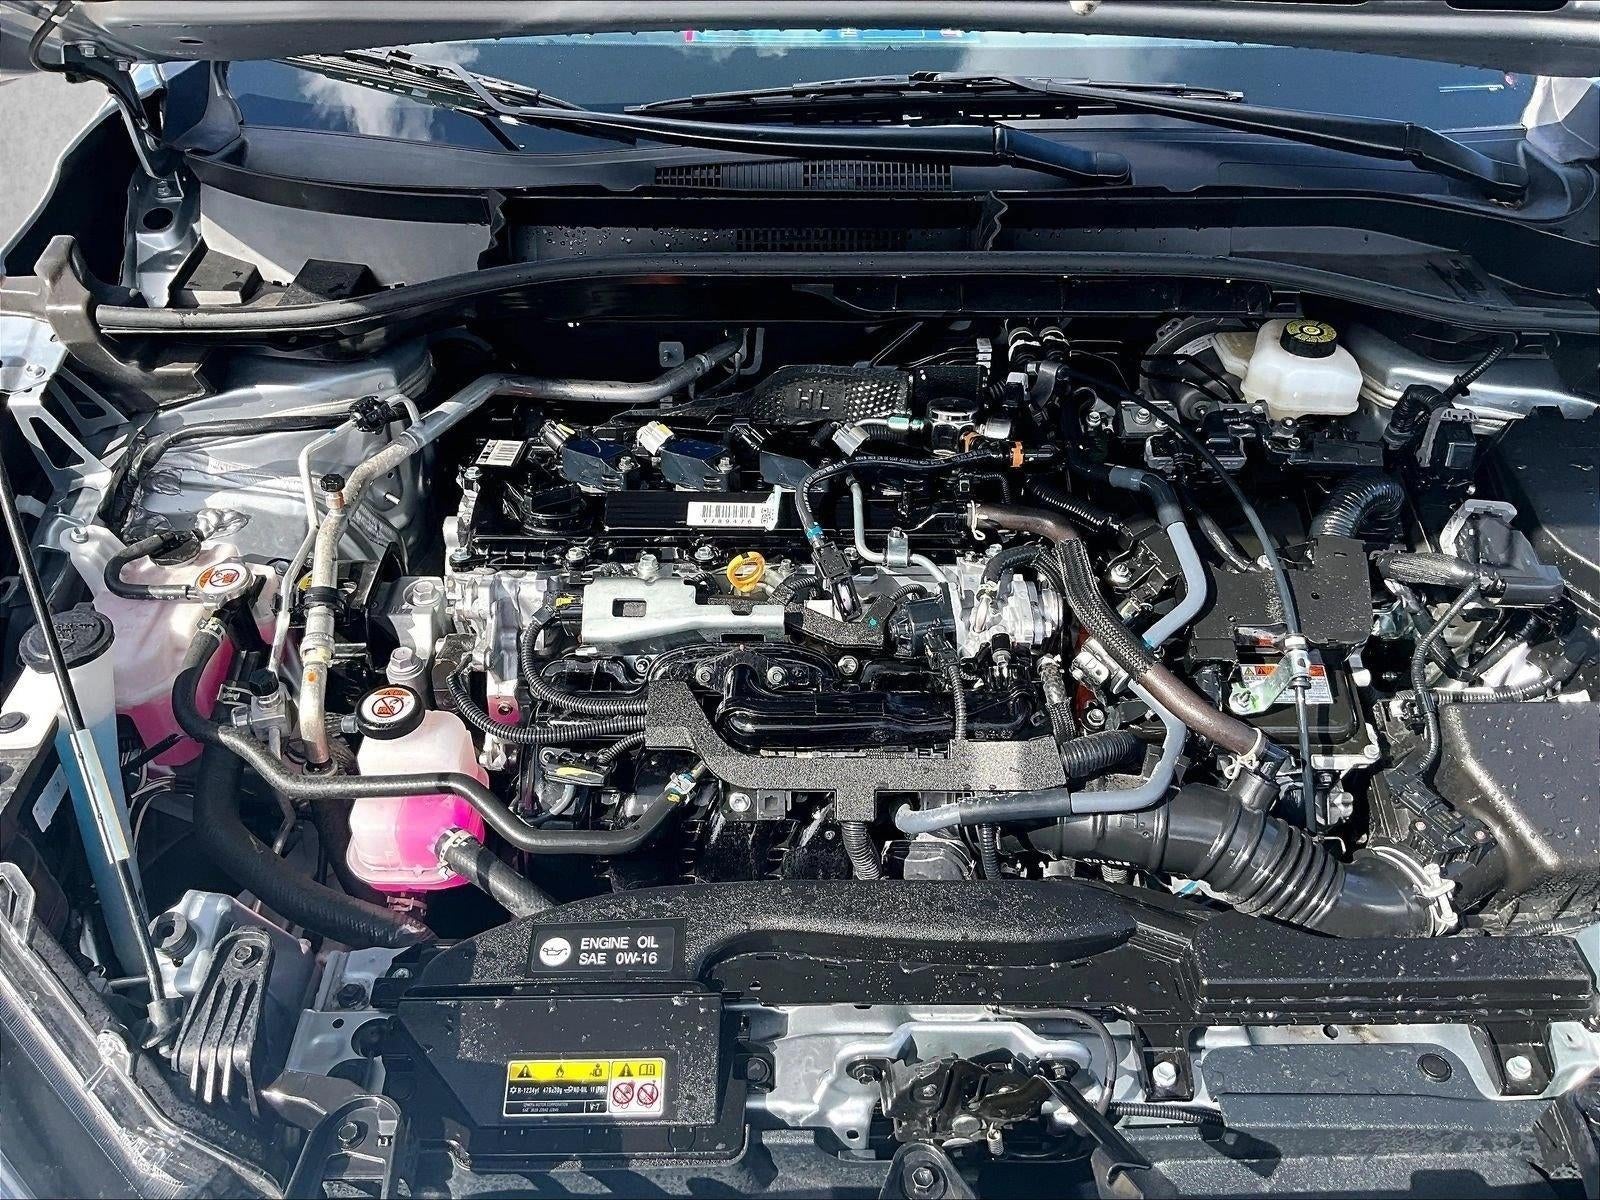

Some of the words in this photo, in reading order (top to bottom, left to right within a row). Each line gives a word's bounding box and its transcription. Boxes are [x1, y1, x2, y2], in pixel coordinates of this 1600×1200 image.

[580, 936, 630, 950] ENGINE
[637, 935, 659, 949] OIL
[578, 952, 607, 965] SAE
[615, 951, 658, 965] 0W-16
